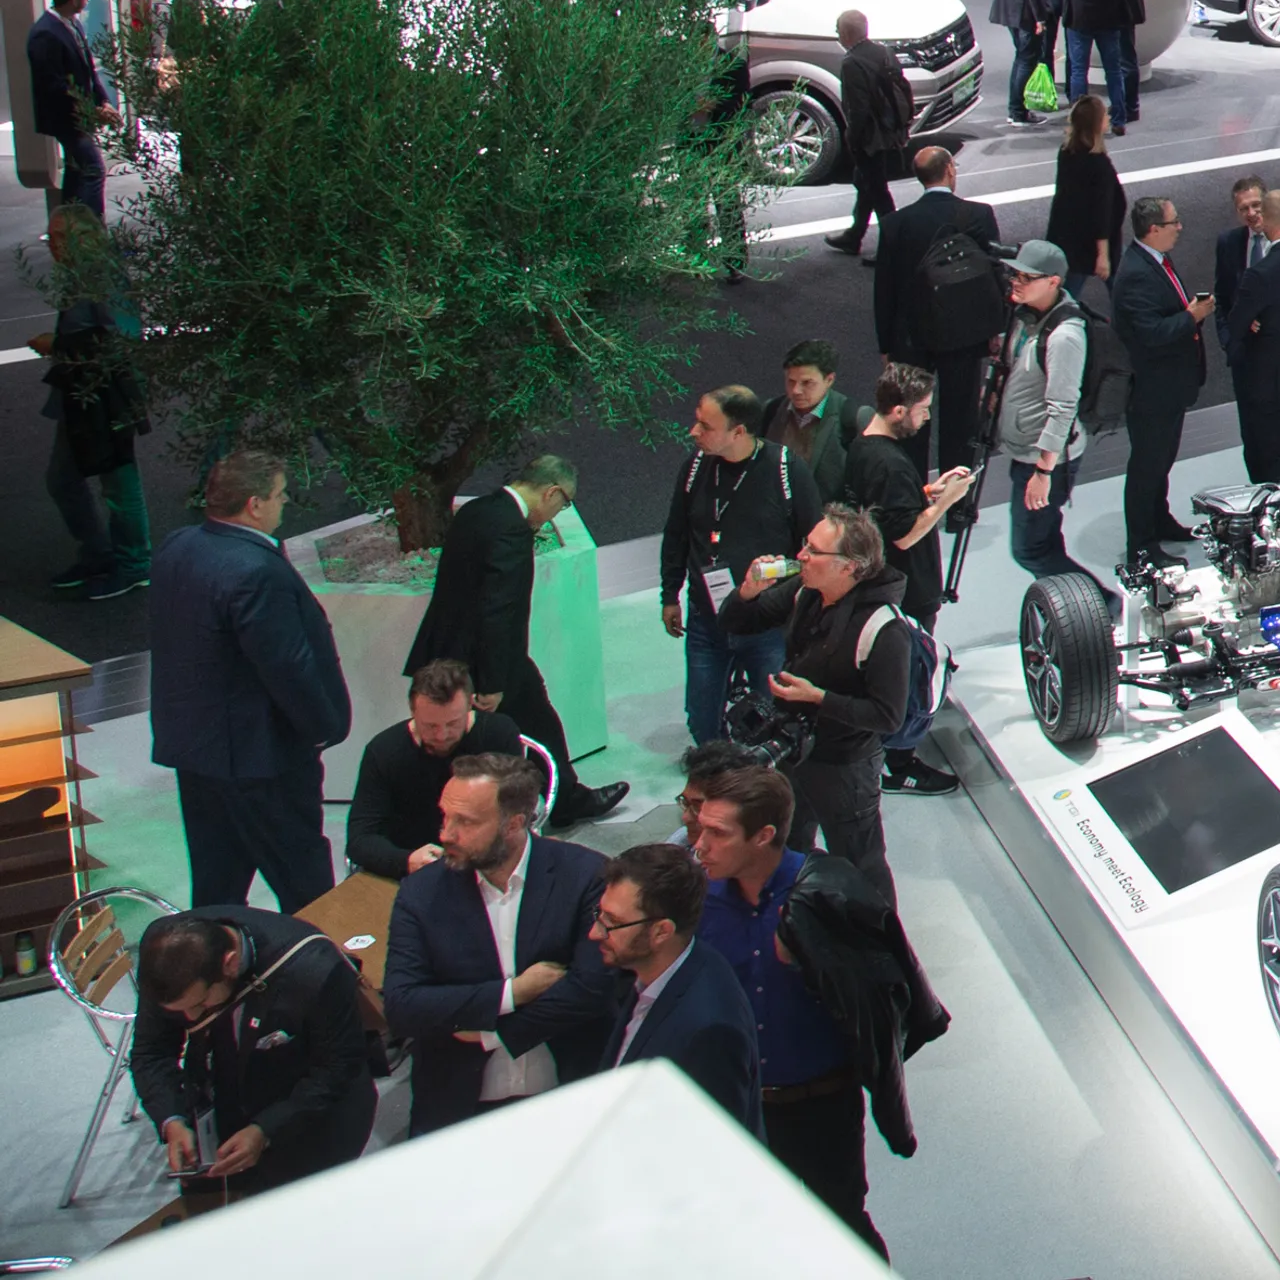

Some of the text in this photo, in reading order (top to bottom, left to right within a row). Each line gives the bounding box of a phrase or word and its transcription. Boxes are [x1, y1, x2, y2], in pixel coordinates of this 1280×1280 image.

[685, 457, 701, 493] RENAULT
[780, 464, 793, 500] RENAULT
[1076, 817, 1109, 859] Economy
[1103, 857, 1126, 879] meet
[1118, 875, 1151, 914] Ecology
